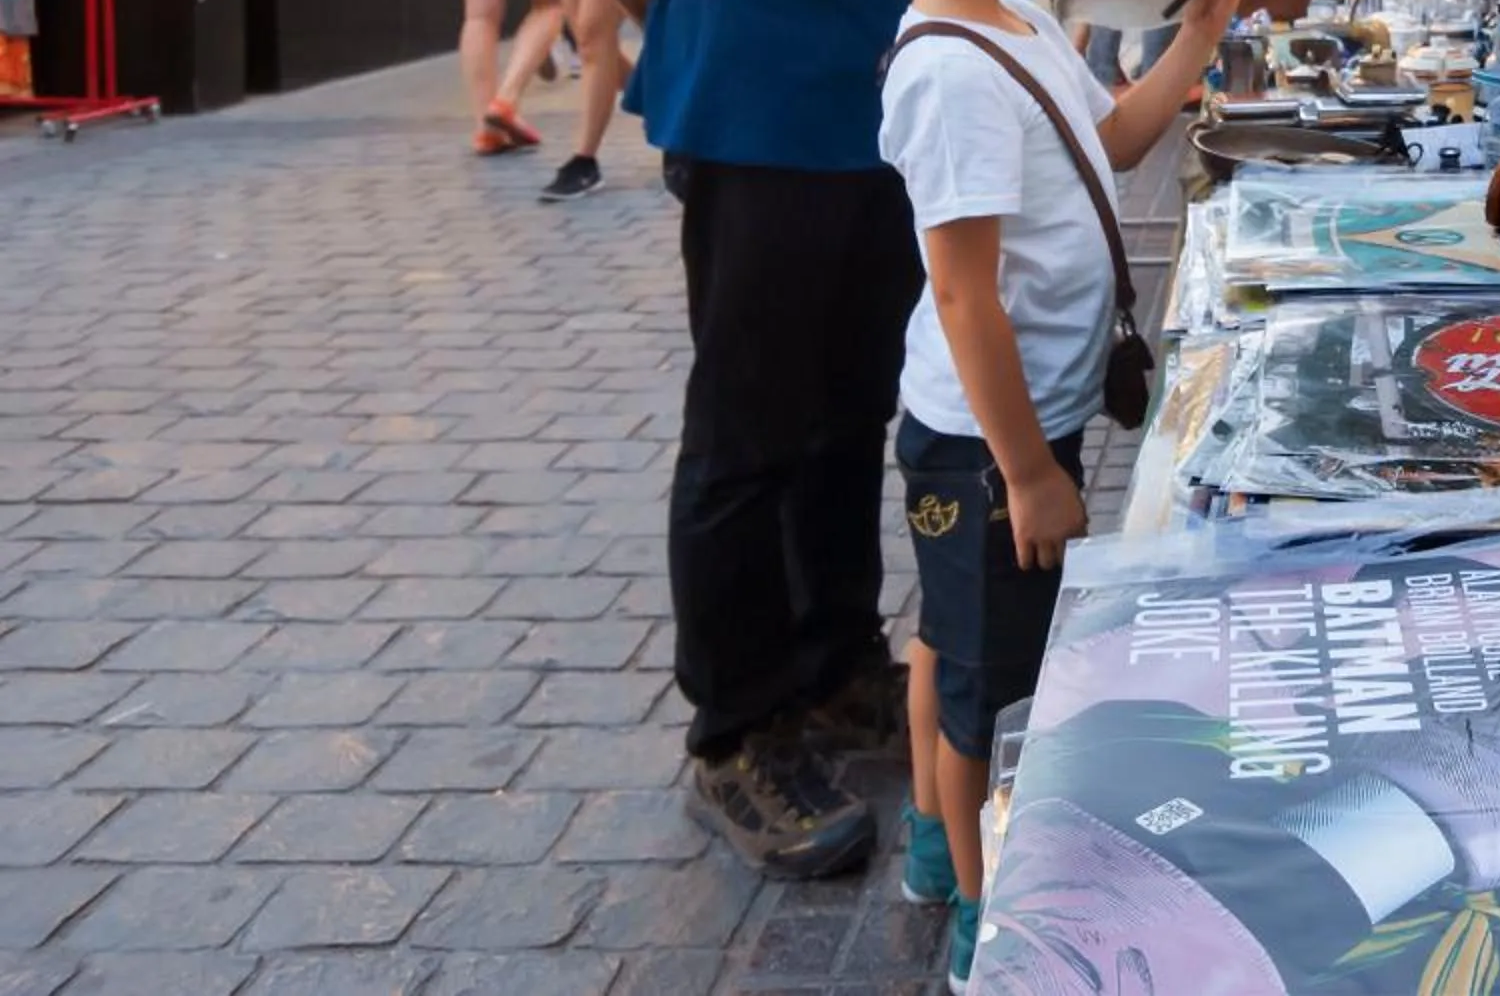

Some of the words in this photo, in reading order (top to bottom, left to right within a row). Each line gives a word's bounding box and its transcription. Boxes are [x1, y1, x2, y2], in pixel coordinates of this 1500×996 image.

[1128, 590, 1222, 665] JOKE
[1229, 583, 1319, 637] THE
[1405, 572, 1466, 628] BRIAN
[1320, 578, 1423, 735] BATMAN
[1418, 629, 1488, 714] BOLLAND
[1229, 646, 1332, 780] KILLING
